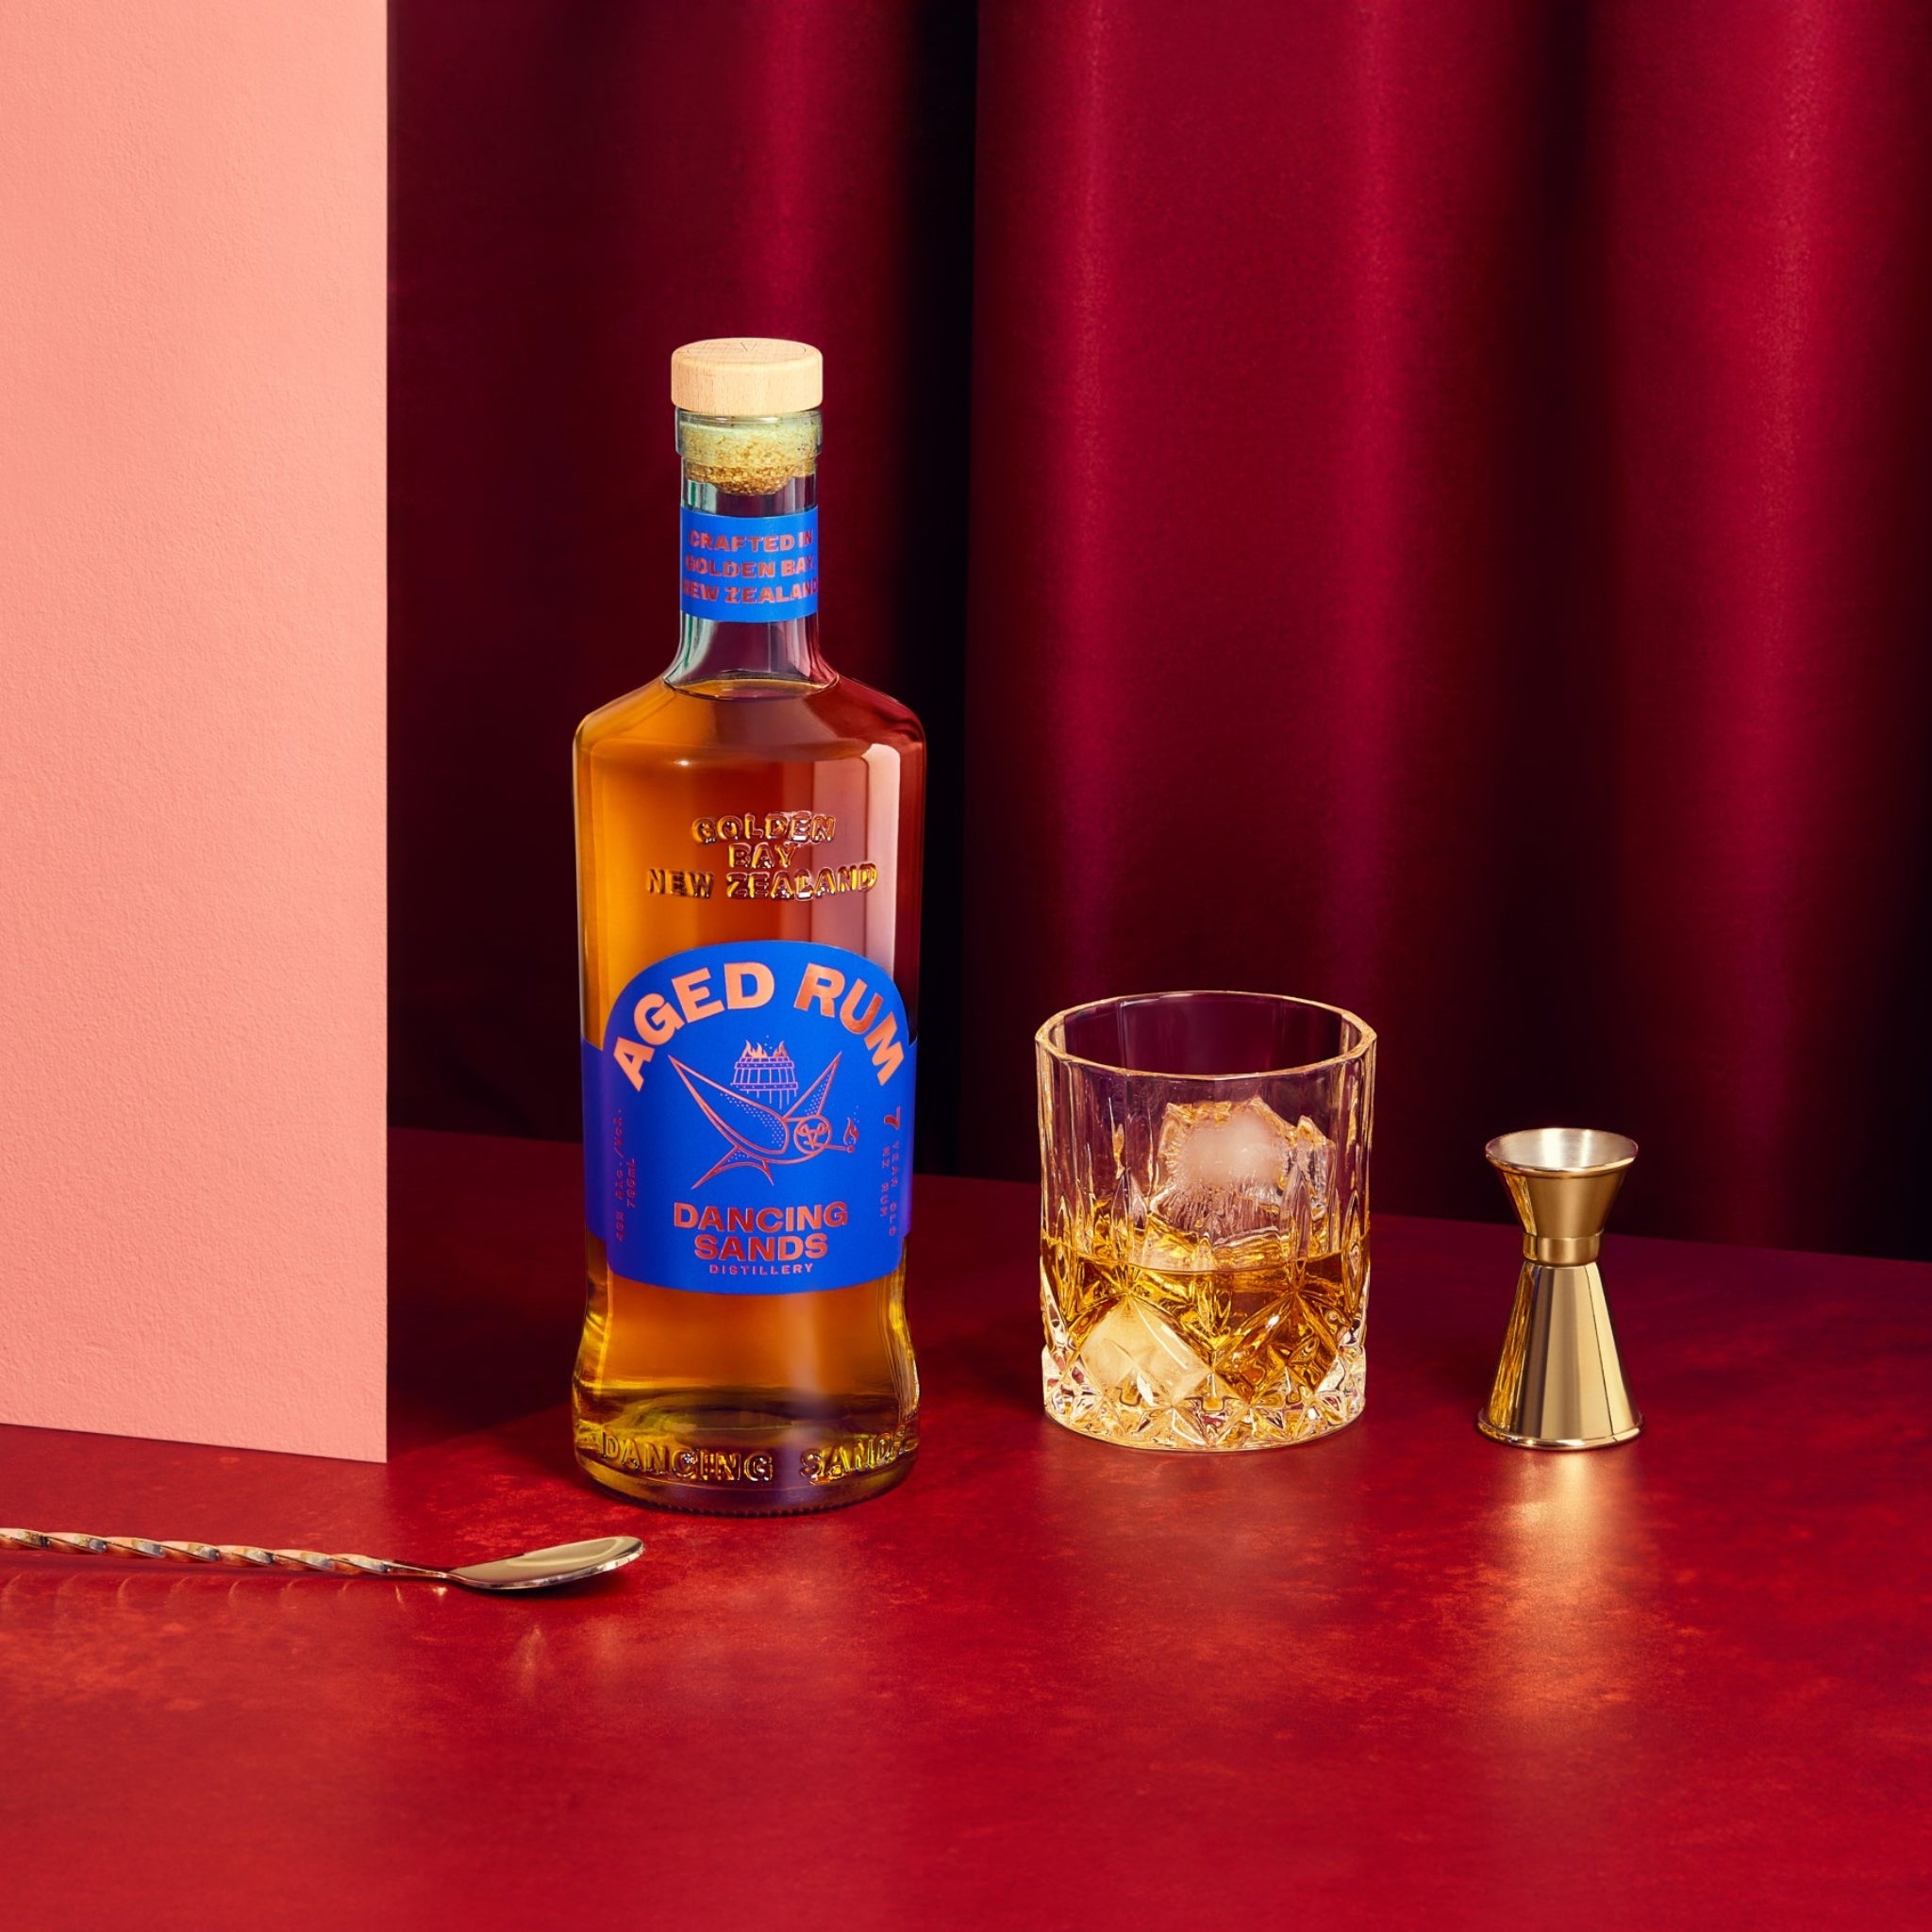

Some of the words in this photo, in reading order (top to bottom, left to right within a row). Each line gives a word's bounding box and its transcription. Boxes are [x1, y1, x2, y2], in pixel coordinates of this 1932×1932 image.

[689, 530, 795, 553] CRAFTED
[798, 529, 813, 548] IN
[685, 555, 775, 578] GOLDEN
[780, 557, 813, 577] BAY
[682, 580, 720, 602] NEW
[724, 578, 818, 604] ZEALAND
[691, 811, 836, 843] GOLDEN
[727, 842, 797, 869] BAY
[646, 868, 714, 898] NEW
[725, 863, 878, 900] ZEALAND
[613, 961, 775, 1092] AGED
[793, 962, 904, 1087] RUM
[884, 1106, 901, 1130] 7
[674, 1202, 847, 1232] DANCING
[694, 1233, 828, 1261] SANDS
[709, 1263, 813, 1275] DISTILLERY
[601, 1427, 774, 1482] DANCING
